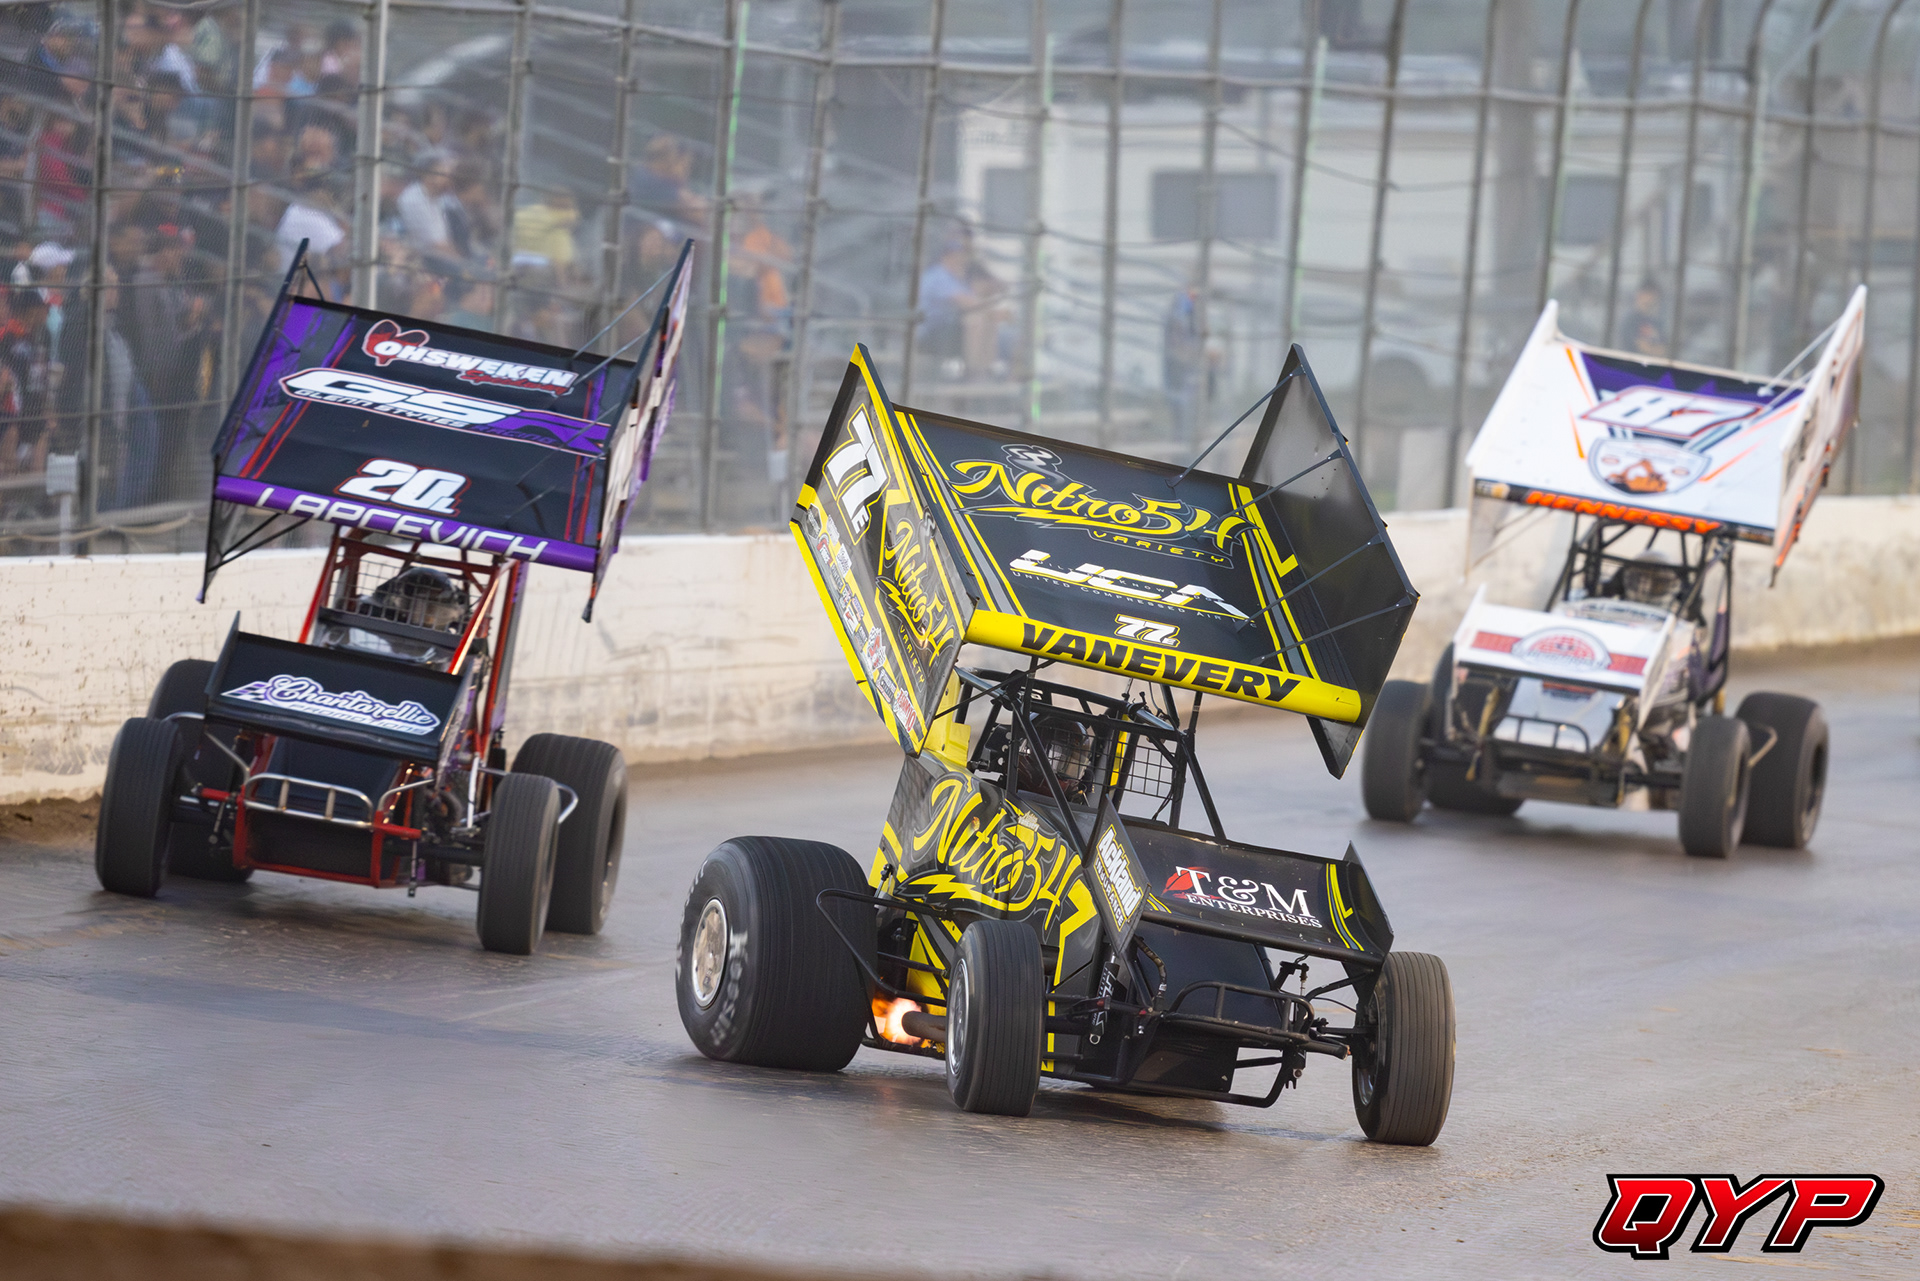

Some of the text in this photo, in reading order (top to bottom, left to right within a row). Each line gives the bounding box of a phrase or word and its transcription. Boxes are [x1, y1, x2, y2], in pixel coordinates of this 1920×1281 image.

[374, 341, 576, 388] OHSWEKEN
[294, 389, 373, 407] GLENN
[374, 404, 470, 428] STYRES
[827, 411, 887, 534] 77E
[255, 487, 548, 562] LAPCEVICH
[1526, 490, 1721, 535] HENNESSY
[1093, 530, 1225, 563] VARIETY
[1012, 571, 1071, 588] UNITED
[1080, 586, 1186, 613] COMPRESSED
[1196, 611, 1222, 621] AIR
[899, 623, 926, 684] VARIETY
[1021, 622, 1302, 702] VANEVERY
[270, 678, 435, 725] Chantarellie
[913, 778, 1082, 931] Nitro54
[1098, 828, 1142, 918] Ackland
[1094, 857, 1124, 927] INSURANCE
[1185, 893, 1323, 929] ENTERPRISES
